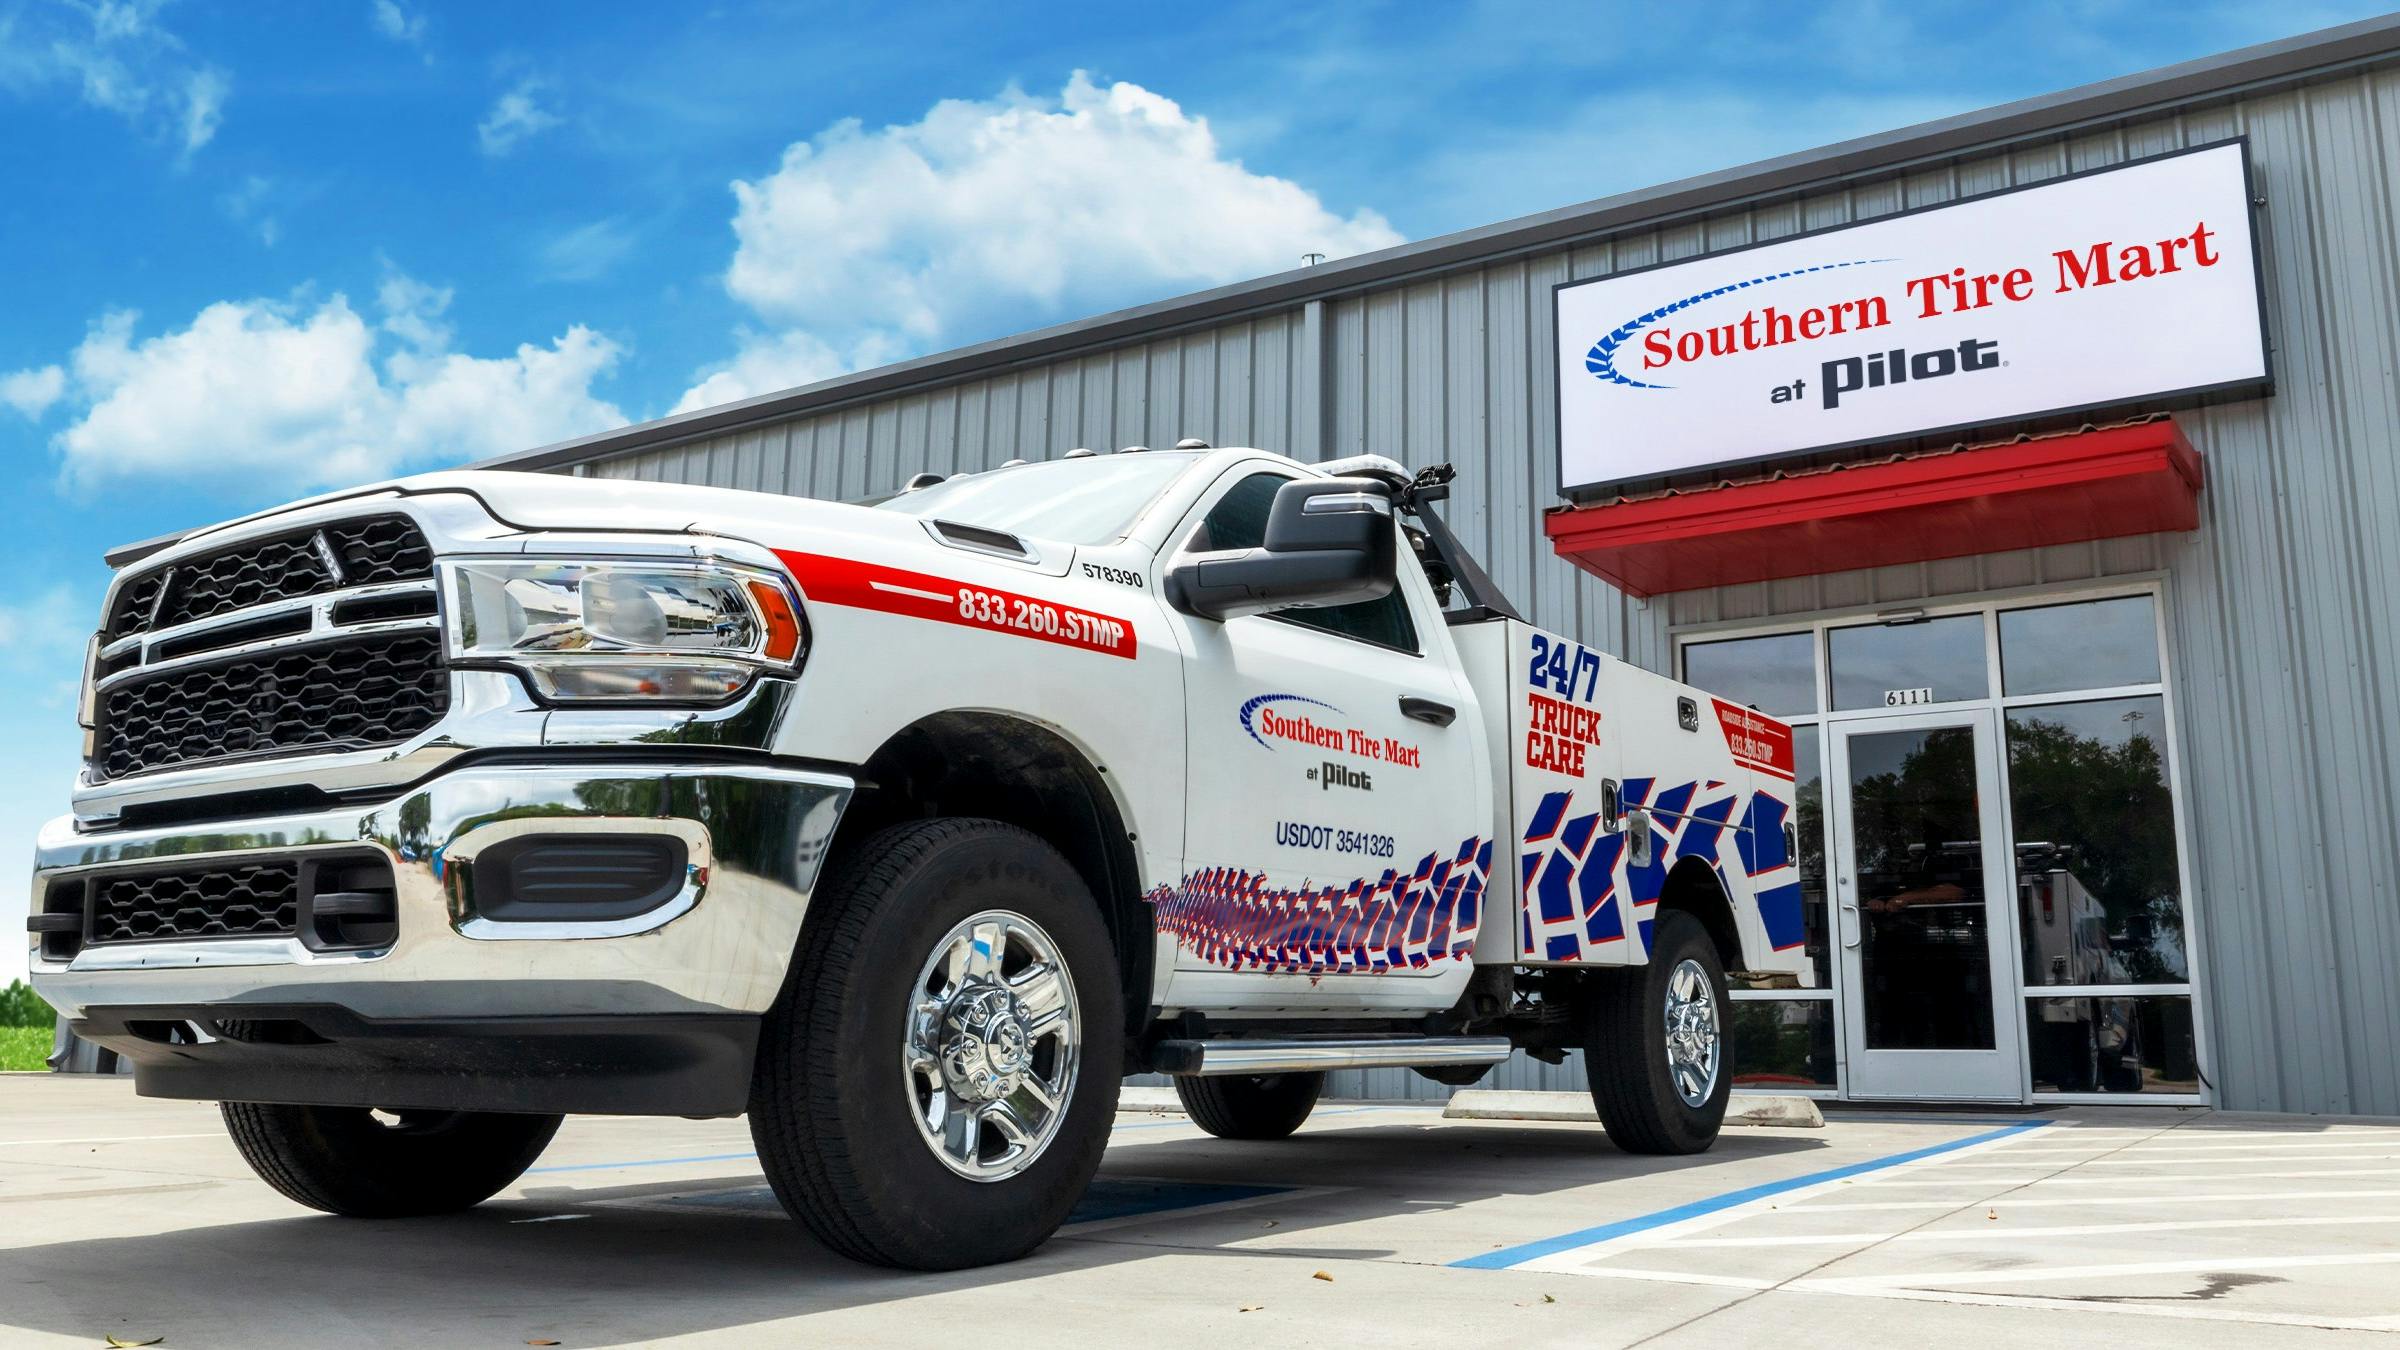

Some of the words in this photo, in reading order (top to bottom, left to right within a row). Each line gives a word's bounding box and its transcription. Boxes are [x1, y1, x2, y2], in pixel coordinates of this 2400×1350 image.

[1643, 296, 1892, 370] Southern
[1906, 267, 2034, 319] Tire
[2051, 221, 2219, 294] Mart
[1770, 378, 1806, 404] at
[1082, 562, 1144, 588] 578390
[958, 588, 1125, 649] 833.260.STMP
[1529, 633, 1601, 703] 24/7
[1886, 688, 1930, 706] 6111
[1262, 708, 1344, 752] Southern
[1347, 729, 1381, 760] Tire
[1384, 738, 1421, 769] Mart
[1528, 692, 1602, 746] TRUCK
[1526, 731, 1585, 778] CARE
[1731, 733, 1773, 764] 833.260.STMP
[1306, 767, 1318, 781] at
[1276, 821, 1334, 850] USDOT
[1336, 830, 1395, 858] 3541326
